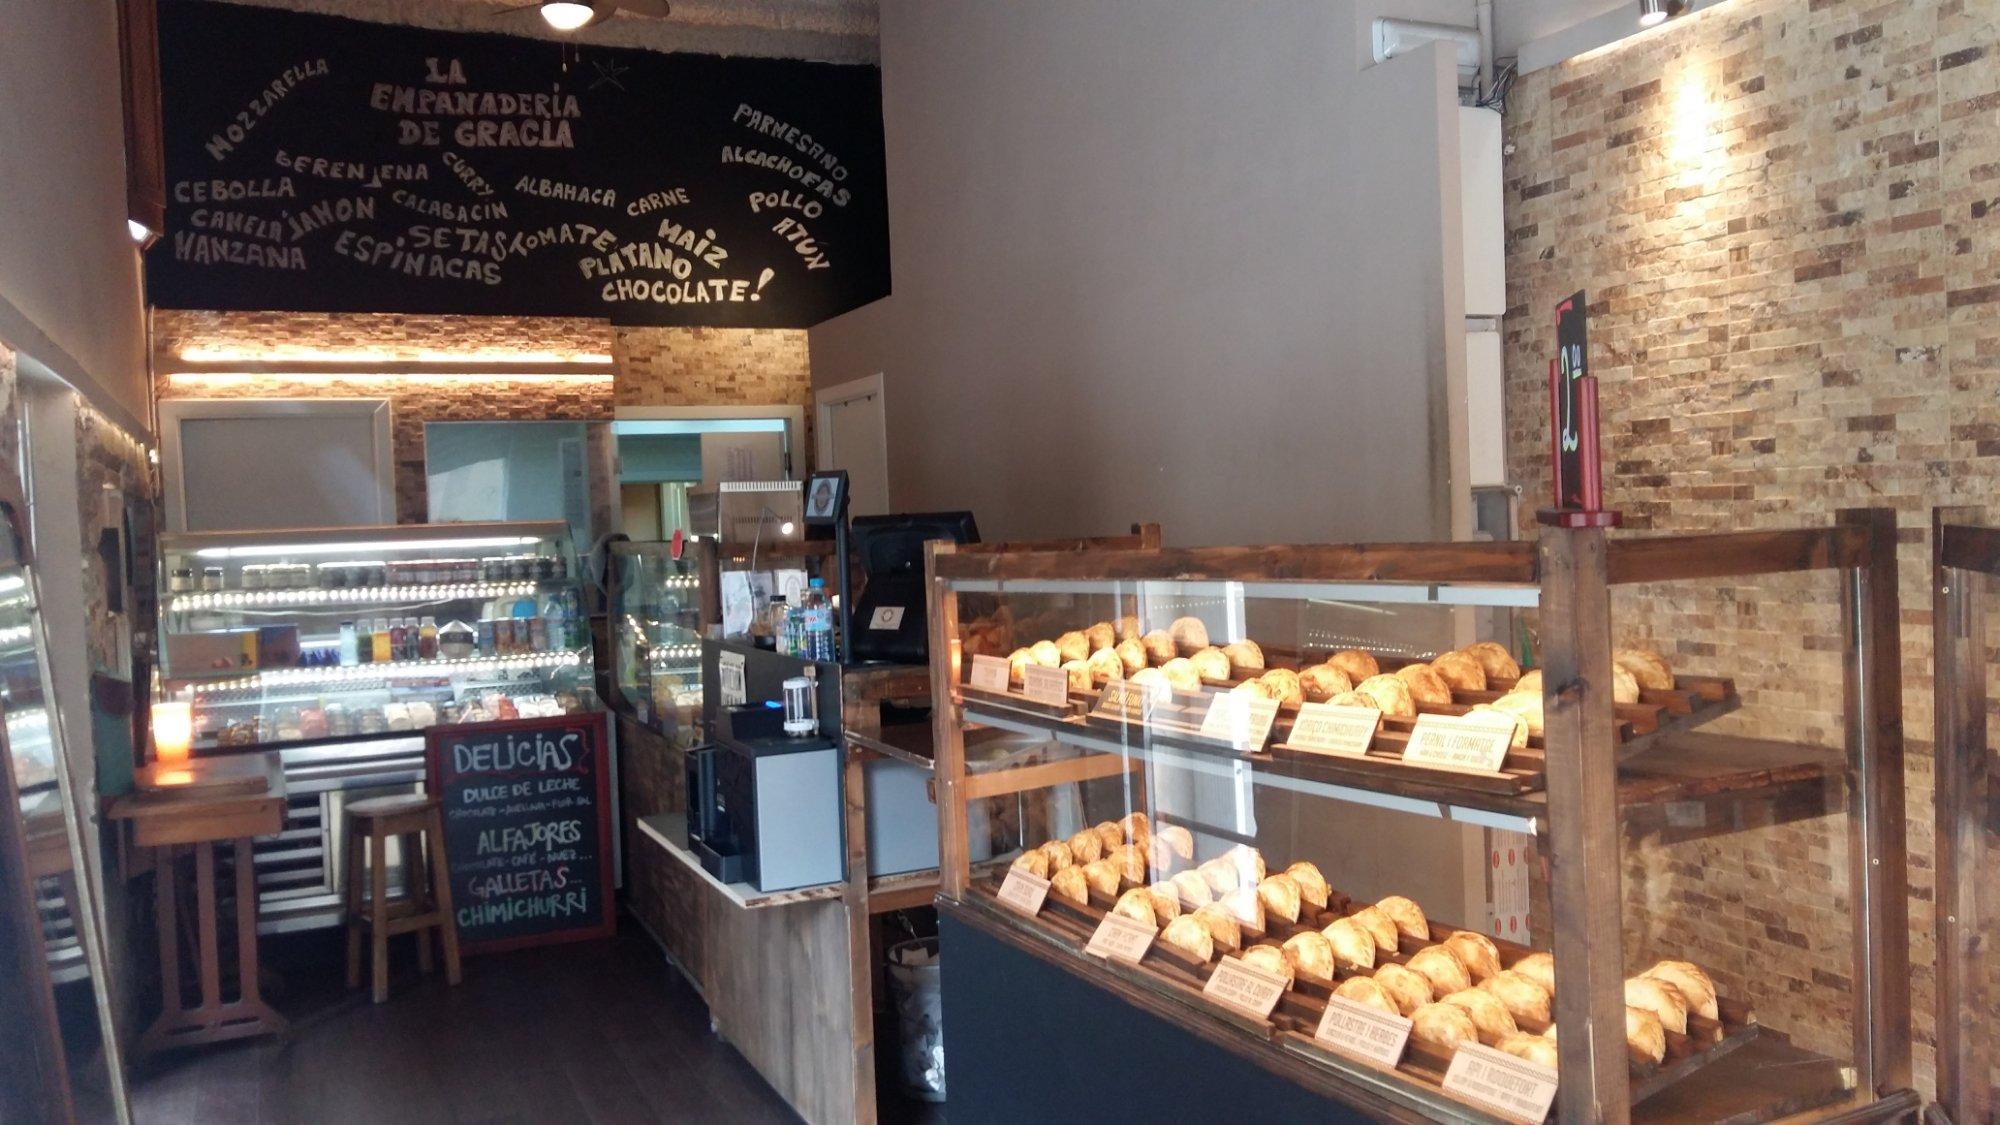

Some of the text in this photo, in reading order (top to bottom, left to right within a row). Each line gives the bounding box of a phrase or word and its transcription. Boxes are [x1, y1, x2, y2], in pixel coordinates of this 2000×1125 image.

[424, 57, 467, 84] LA
[205, 58, 330, 161] MOZZARELLA
[398, 119, 441, 146] DE
[732, 102, 850, 182] PARMESANO
[174, 176, 297, 203] CEBOLLA
[442, 151, 495, 197] CURRY
[391, 189, 509, 223] CALABACIN
[514, 175, 617, 208] ALBAHACA
[626, 187, 691, 217] CARNE
[748, 188, 824, 220] POLLO
[190, 209, 284, 243] CANELA
[288, 196, 376, 242] JAMON
[173, 230, 308, 270] MANZANA
[406, 225, 508, 263] SETAS
[508, 221, 619, 257] TOMATE
[601, 267, 776, 305] CHOCOLATE!
[1421, 731, 1445, 748] PERNIL
[462, 777, 581, 804] DULCE DE LECHE
[477, 819, 582, 856] ALFAJORES
[468, 866, 570, 898] GALLETAS
